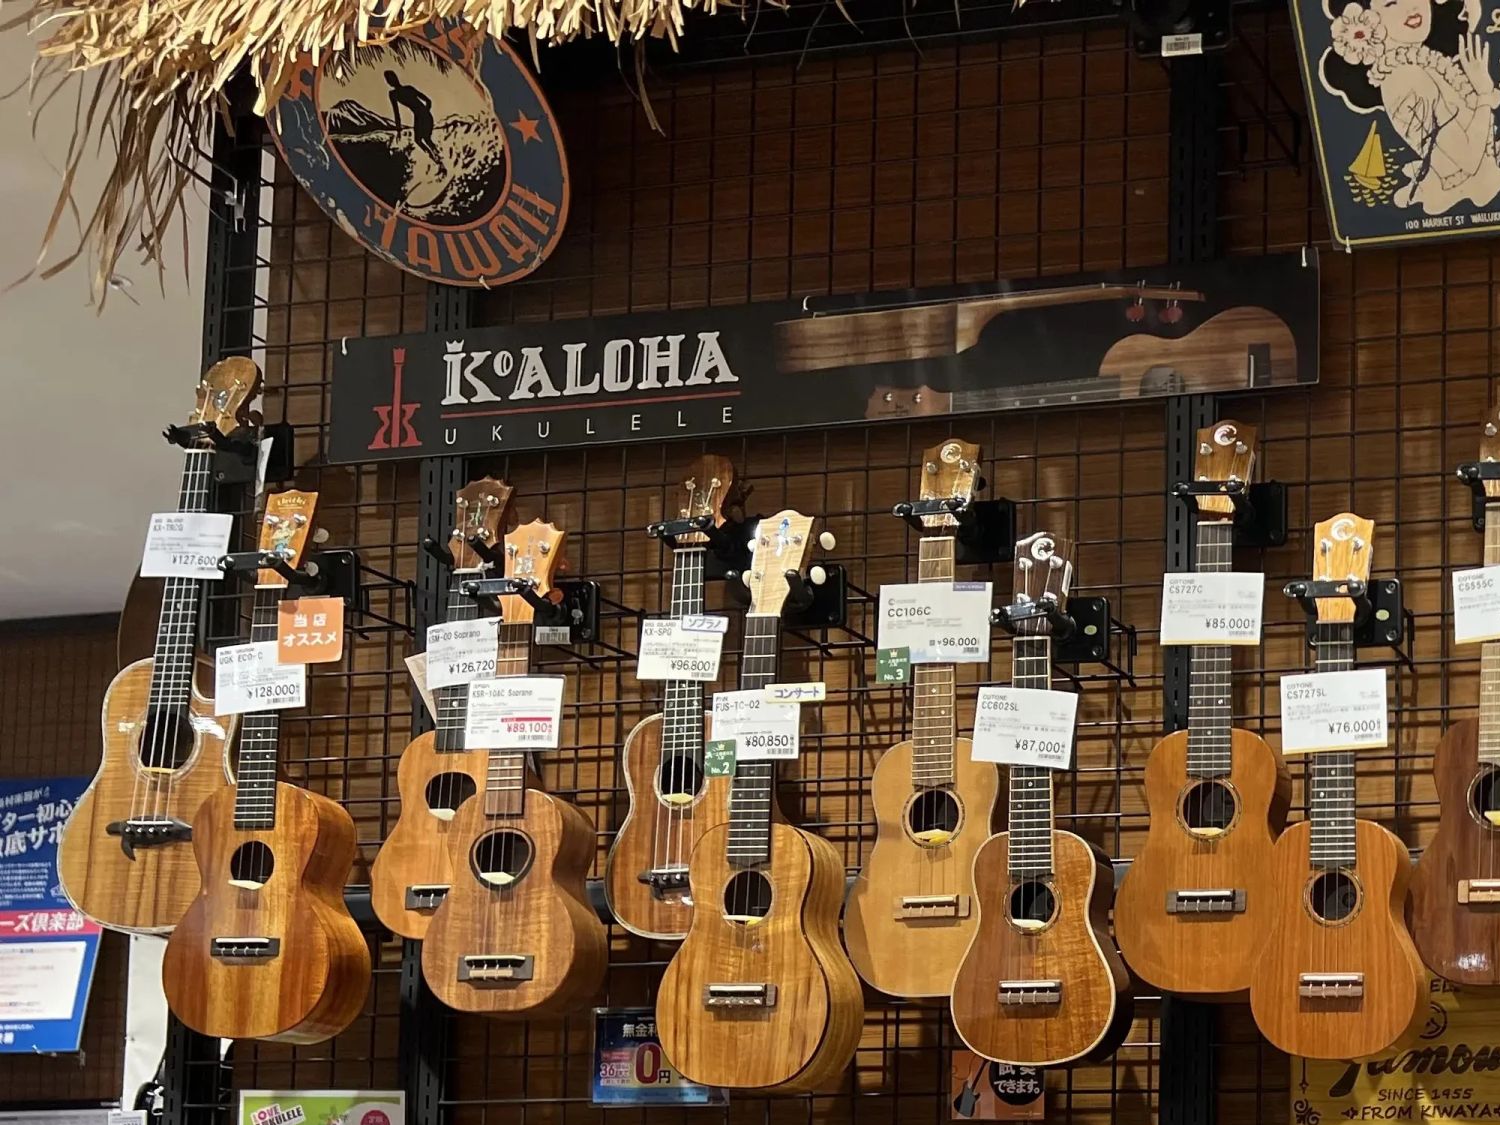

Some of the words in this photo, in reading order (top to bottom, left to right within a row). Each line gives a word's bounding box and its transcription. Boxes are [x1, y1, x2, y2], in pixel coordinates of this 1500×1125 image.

[1405, 220, 1420, 230] 100
[1422, 217, 1453, 229] MARKET
[1455, 216, 1465, 226] ST
[444, 406, 733, 444] UKULELE
[1169, 585, 1203, 594] CS727C
[887, 606, 931, 618] CC106C
[293, 613, 326, 628] 当店
[687, 617, 722, 629] ソプラノ
[1205, 618, 1250, 629] ¥85,000
[283, 631, 337, 648] オススメ
[455, 630, 480, 642] Soprano
[937, 636, 977, 648] ¥96,000
[449, 659, 495, 673] ¥126,720
[670, 659, 711, 672] ¥96,800
[508, 689, 533, 699] Soprano
[773, 686, 820, 699] コンサート
[1287, 689, 1327, 699] CS727SL
[506, 722, 548, 733] ¥89,100
[1328, 719, 1376, 734] ¥76,000
[745, 734, 789, 748] ¥80,850
[1015, 739, 1061, 753] ¥87,000
[994, 1079, 1040, 1096] できます。
[1378, 1087, 1425, 1100] SINCE
[1429, 1087, 1474, 1100] 1955
[253, 1104, 280, 1123] LOVE
[1362, 1105, 1416, 1121] FROM
[1420, 1103, 1494, 1120] KIWAYA
